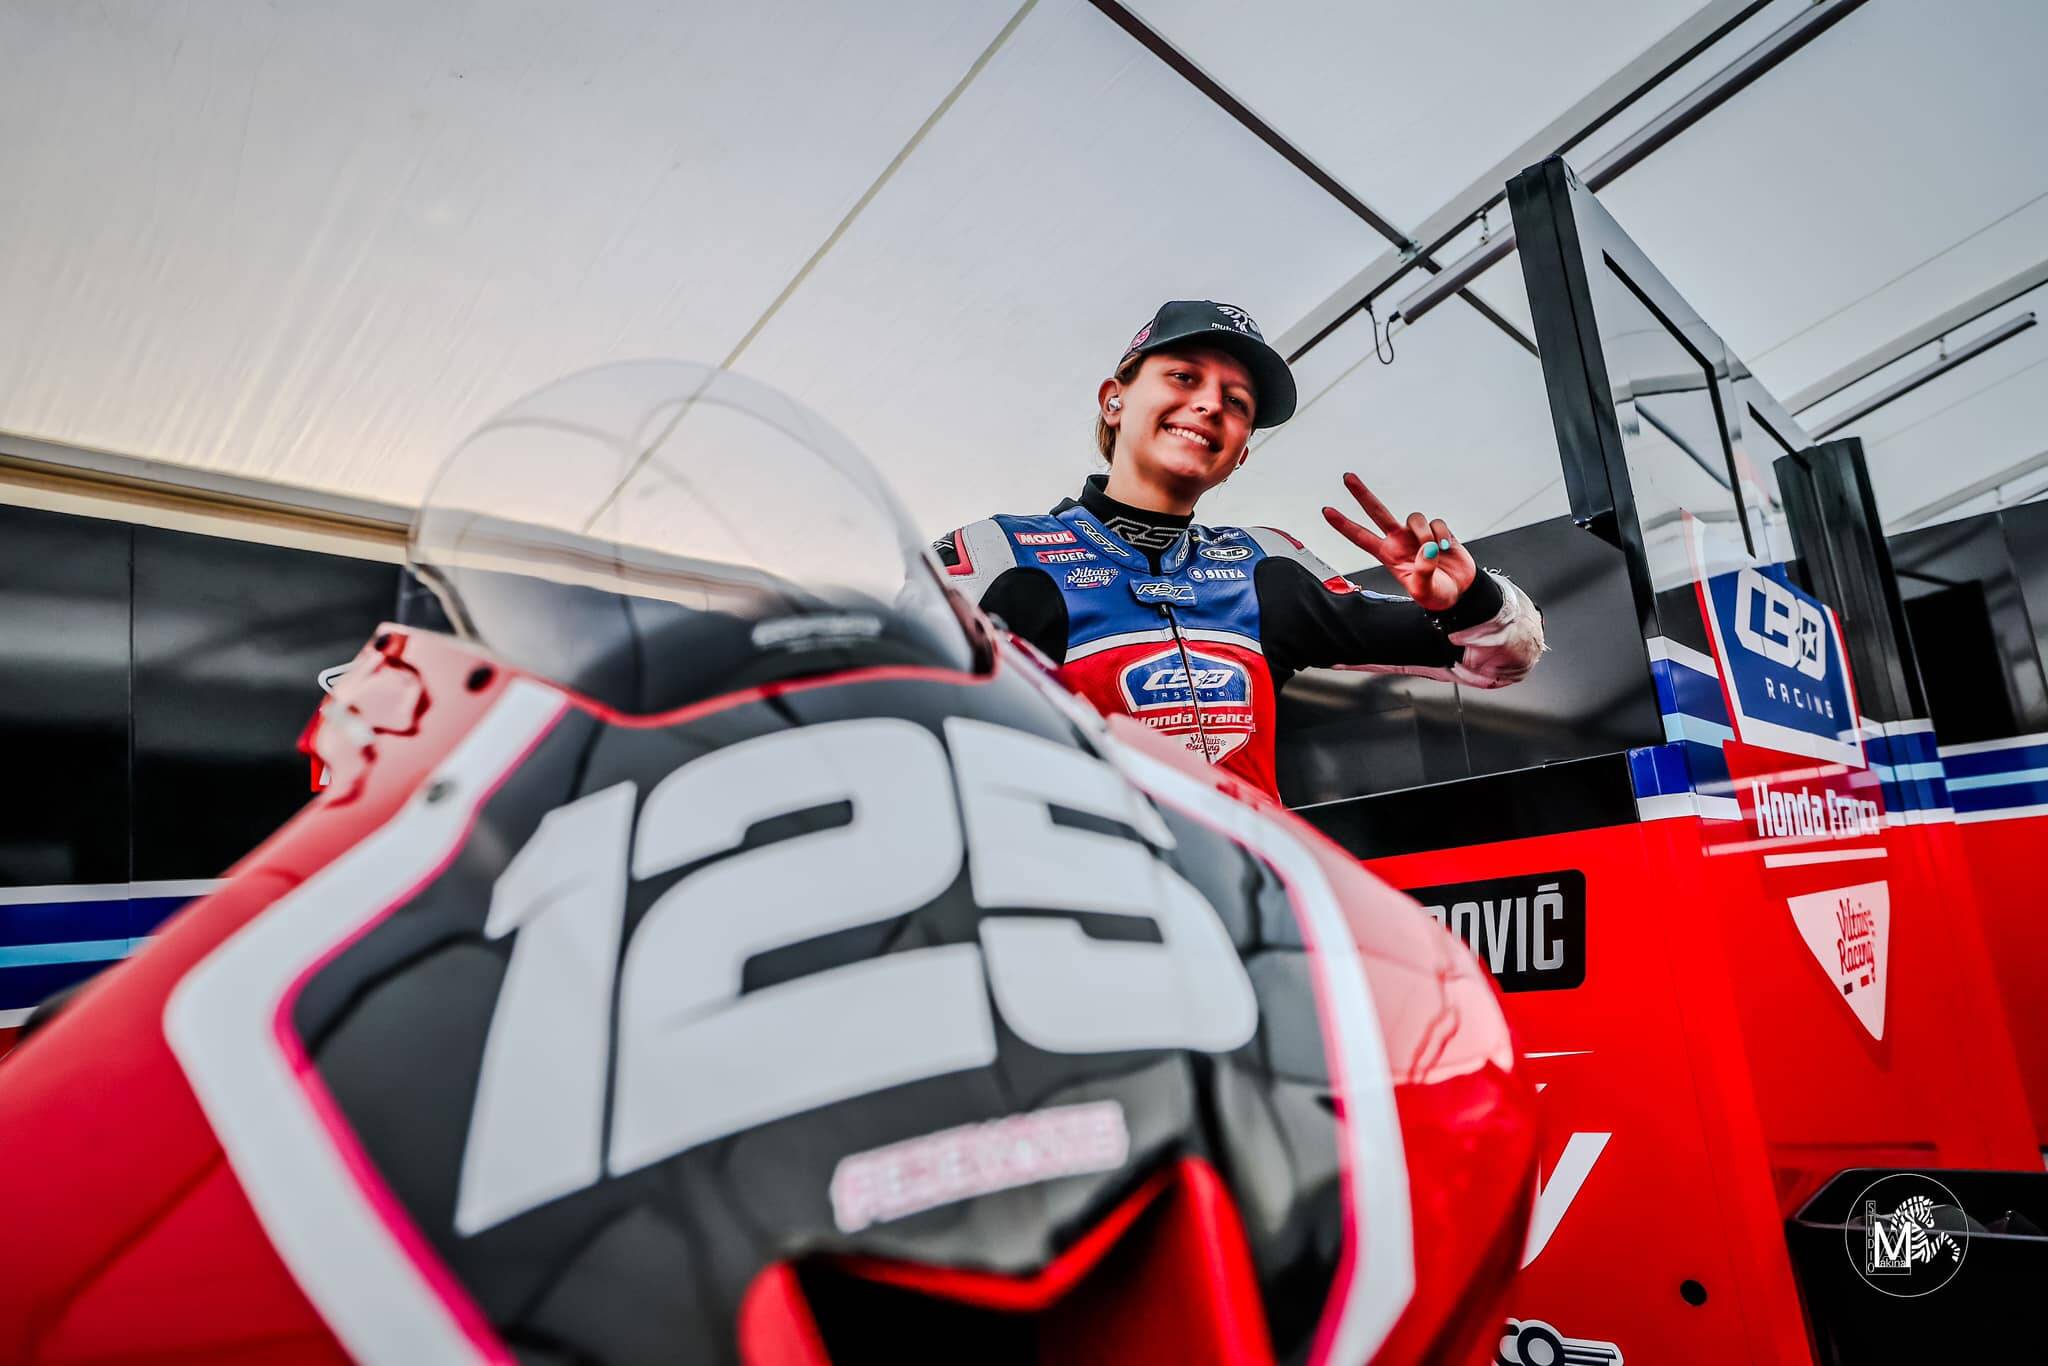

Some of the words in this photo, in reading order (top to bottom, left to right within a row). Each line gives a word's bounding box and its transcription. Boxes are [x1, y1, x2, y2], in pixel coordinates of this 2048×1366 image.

[1019, 531, 1073, 545] MOTUL
[1067, 575, 1111, 585] Racing
[1764, 676, 1834, 719] RACING
[1752, 780, 1826, 837] Honda
[454, 715, 1259, 1240] 125
